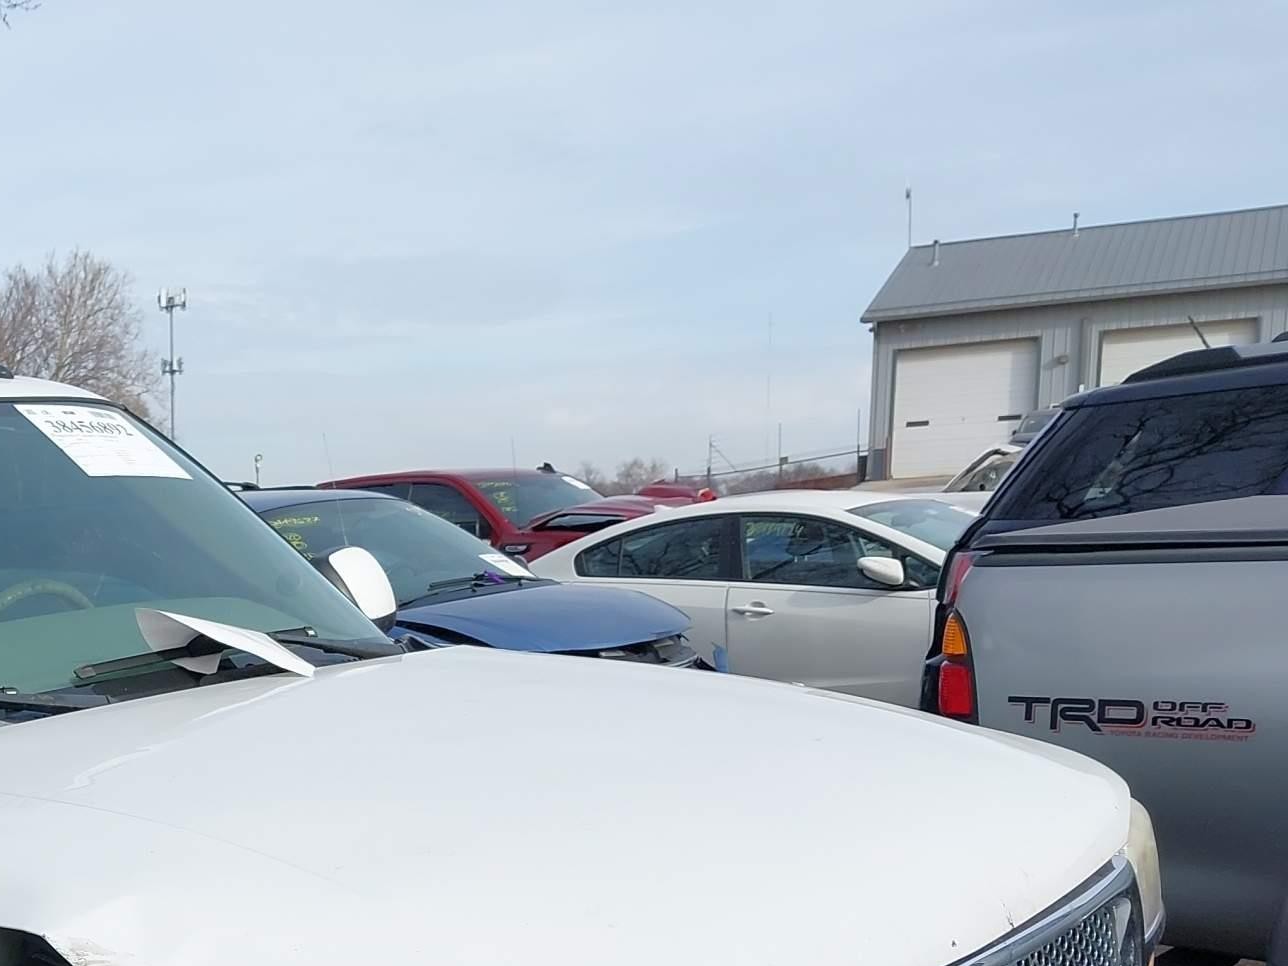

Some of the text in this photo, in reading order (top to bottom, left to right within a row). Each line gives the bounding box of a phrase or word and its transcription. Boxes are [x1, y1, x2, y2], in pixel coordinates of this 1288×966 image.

[44, 419, 134, 437] 38456892
[1007, 695, 1228, 734] TRD OFF
[1151, 715, 1255, 731] ROAD
